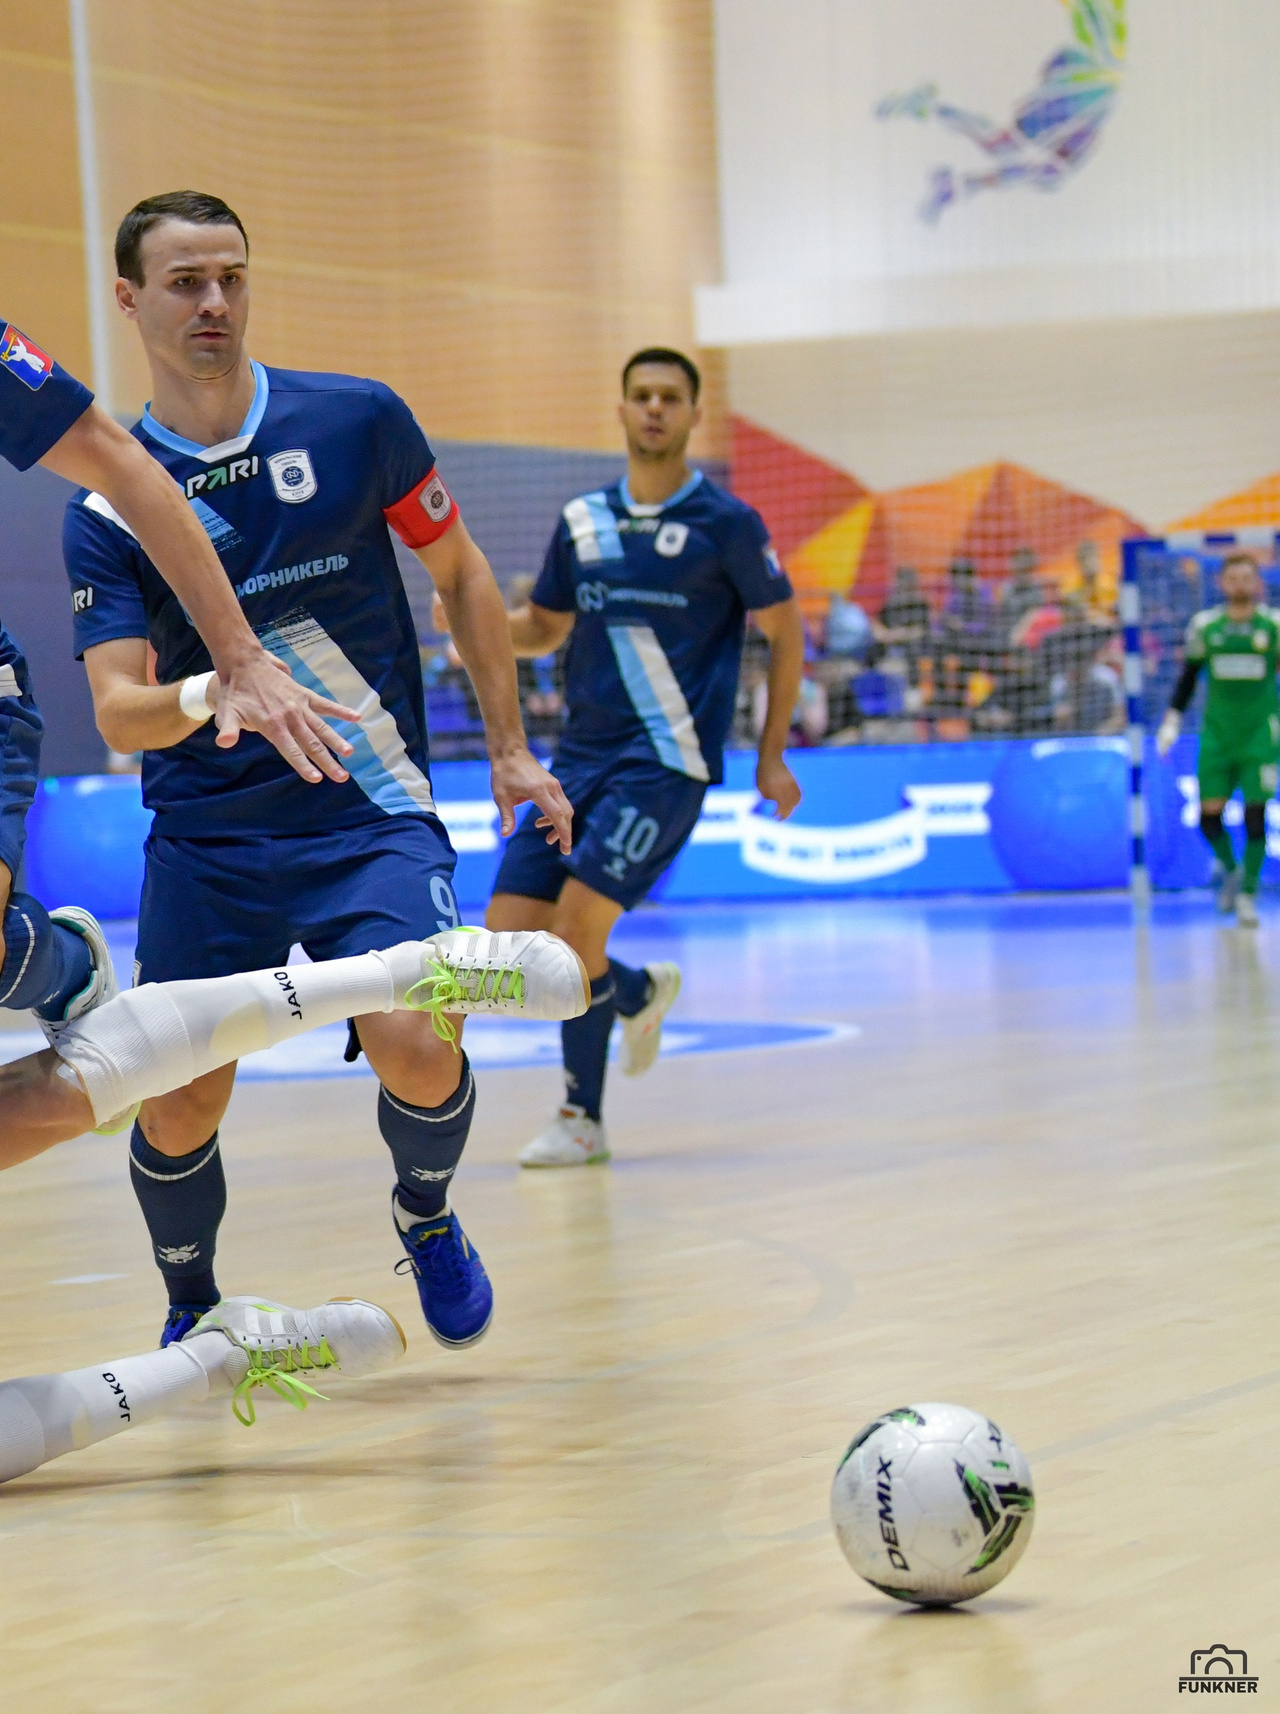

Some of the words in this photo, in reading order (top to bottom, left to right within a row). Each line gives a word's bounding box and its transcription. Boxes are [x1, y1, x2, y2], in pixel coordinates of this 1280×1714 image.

[186, 455, 259, 498] PARI
[604, 805, 660, 864] 10
[429, 875, 459, 932] 9
[274, 971, 302, 1020] JAKO
[102, 1372, 131, 1422] JAKO
[876, 1455, 911, 1572] DEMIX
